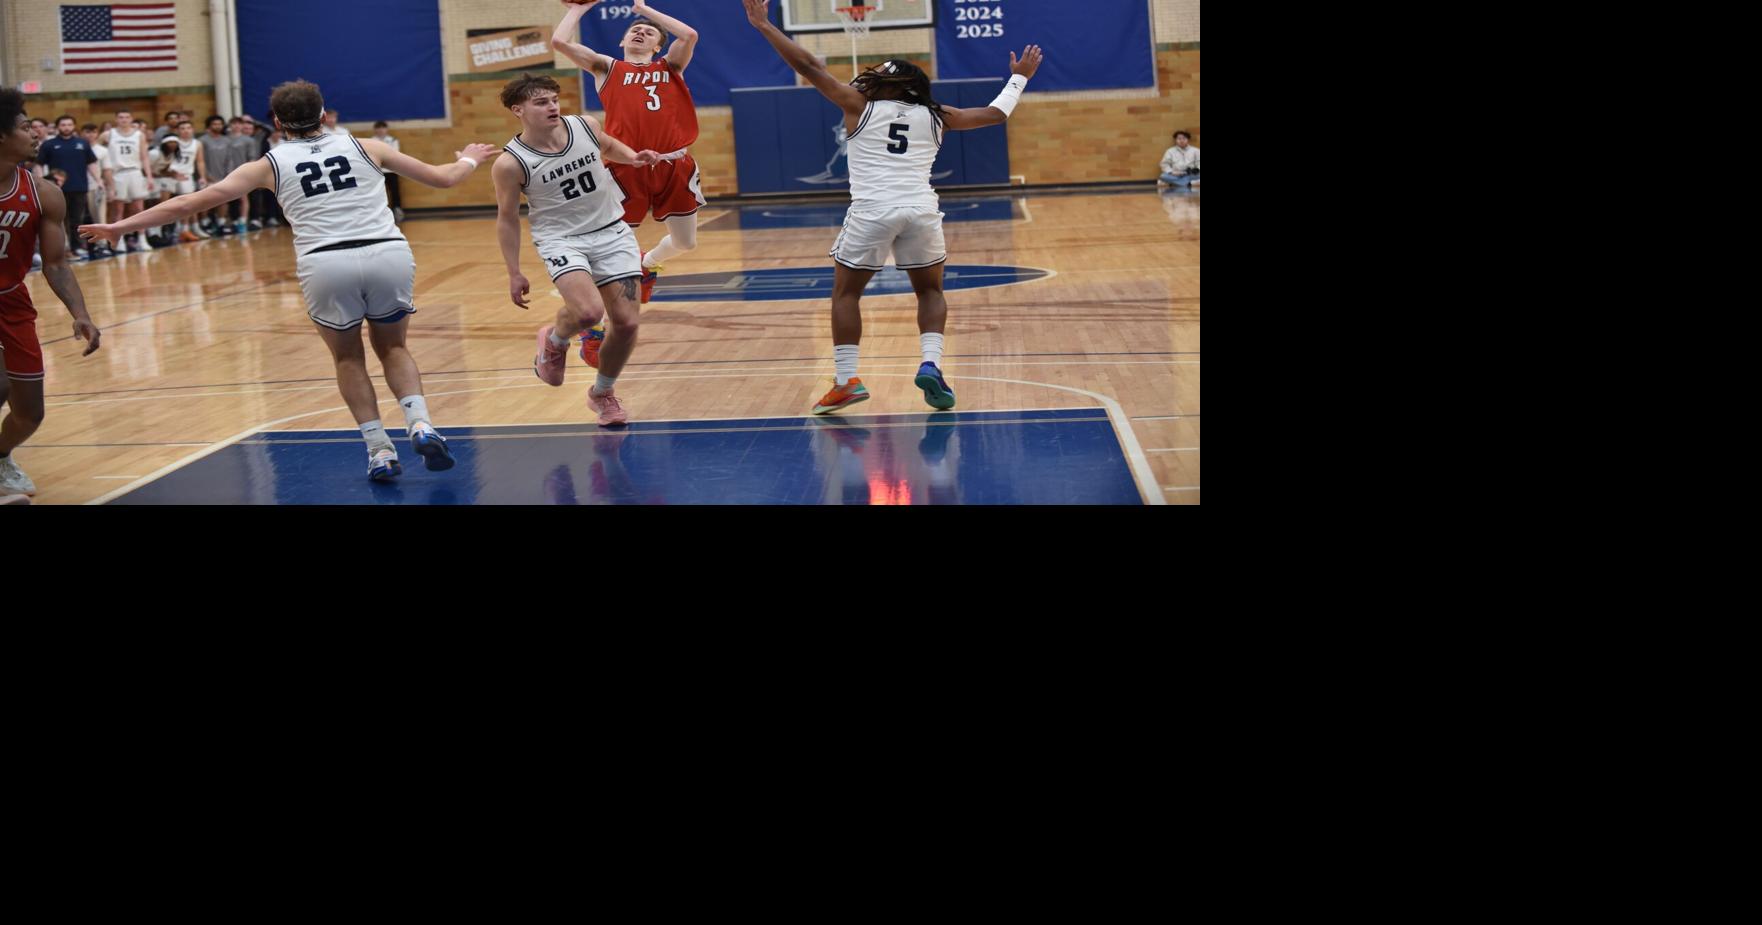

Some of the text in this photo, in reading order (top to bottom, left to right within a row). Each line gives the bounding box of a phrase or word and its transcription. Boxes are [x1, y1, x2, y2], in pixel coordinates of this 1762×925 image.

[600, 5, 641, 20] 199
[955, 6, 1004, 21] 2024
[956, 23, 1004, 39] 2025
[469, 37, 513, 55] GIVING
[472, 41, 549, 68] CHALLENGE
[623, 71, 670, 86] RIPON
[644, 85, 661, 111] 3
[887, 123, 910, 155] 5
[295, 155, 358, 198] 22
[541, 152, 597, 184] LAWRENCE
[559, 170, 597, 201] 20
